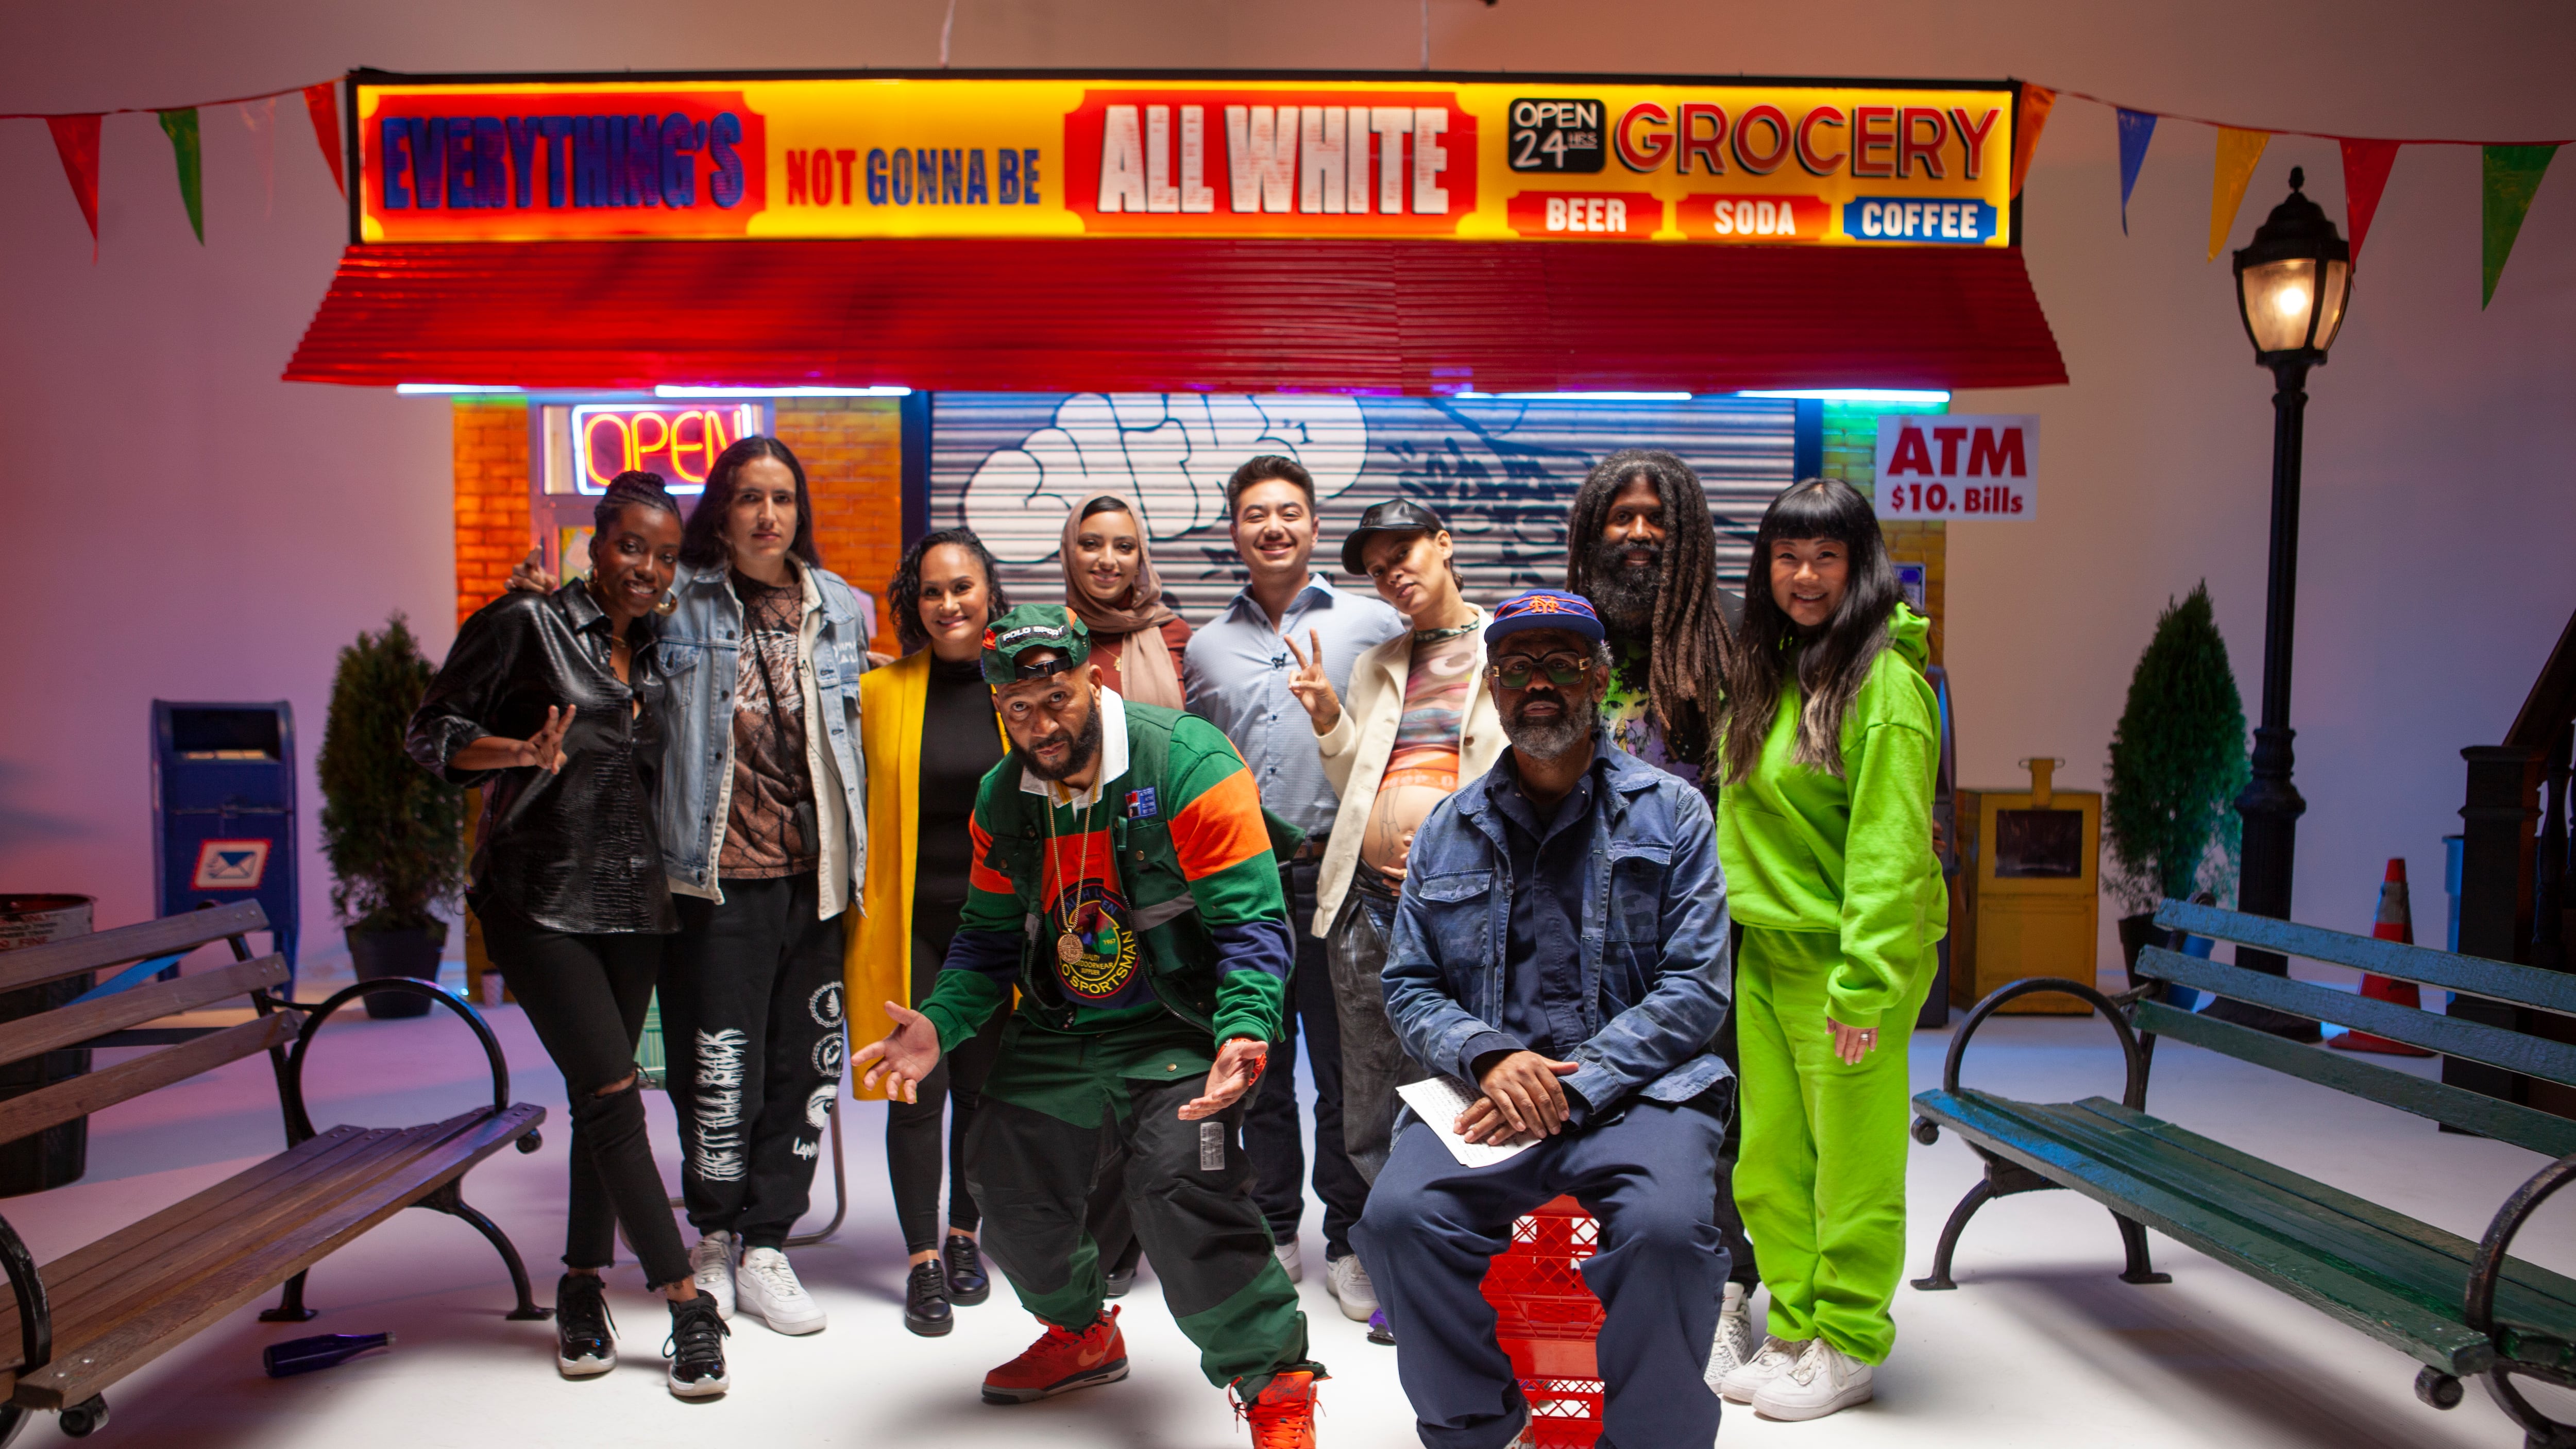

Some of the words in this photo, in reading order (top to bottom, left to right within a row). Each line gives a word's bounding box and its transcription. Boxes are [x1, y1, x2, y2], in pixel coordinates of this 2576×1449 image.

[1514, 101, 1597, 128] OPEN
[1513, 129, 1568, 168] 24
[1614, 103, 2003, 179] GROCERY
[381, 112, 744, 210] EVERYTHING'S
[786, 148, 856, 207] NOT
[867, 148, 990, 207] GONNA
[998, 148, 1041, 206] BE
[1097, 105, 1214, 214] ALL
[1224, 105, 1449, 215] WHITE
[1546, 197, 1626, 232] BEER
[1714, 201, 1796, 235] SODA
[1862, 202, 1977, 238] COFFEE
[1887, 427, 2027, 478] ATM
[1891, 483, 1956, 514] $10.
[1964, 486, 2023, 514] Bills
[1003, 626, 1031, 641] POLO
[1033, 625, 1064, 636] SPORT
[1070, 931, 1137, 993] SPORTSMAN
[693, 1028, 750, 1088] BACK
[693, 1089, 744, 1130] ALL
[693, 1123, 745, 1148] IT
[692, 1146, 747, 1181] TAKE
